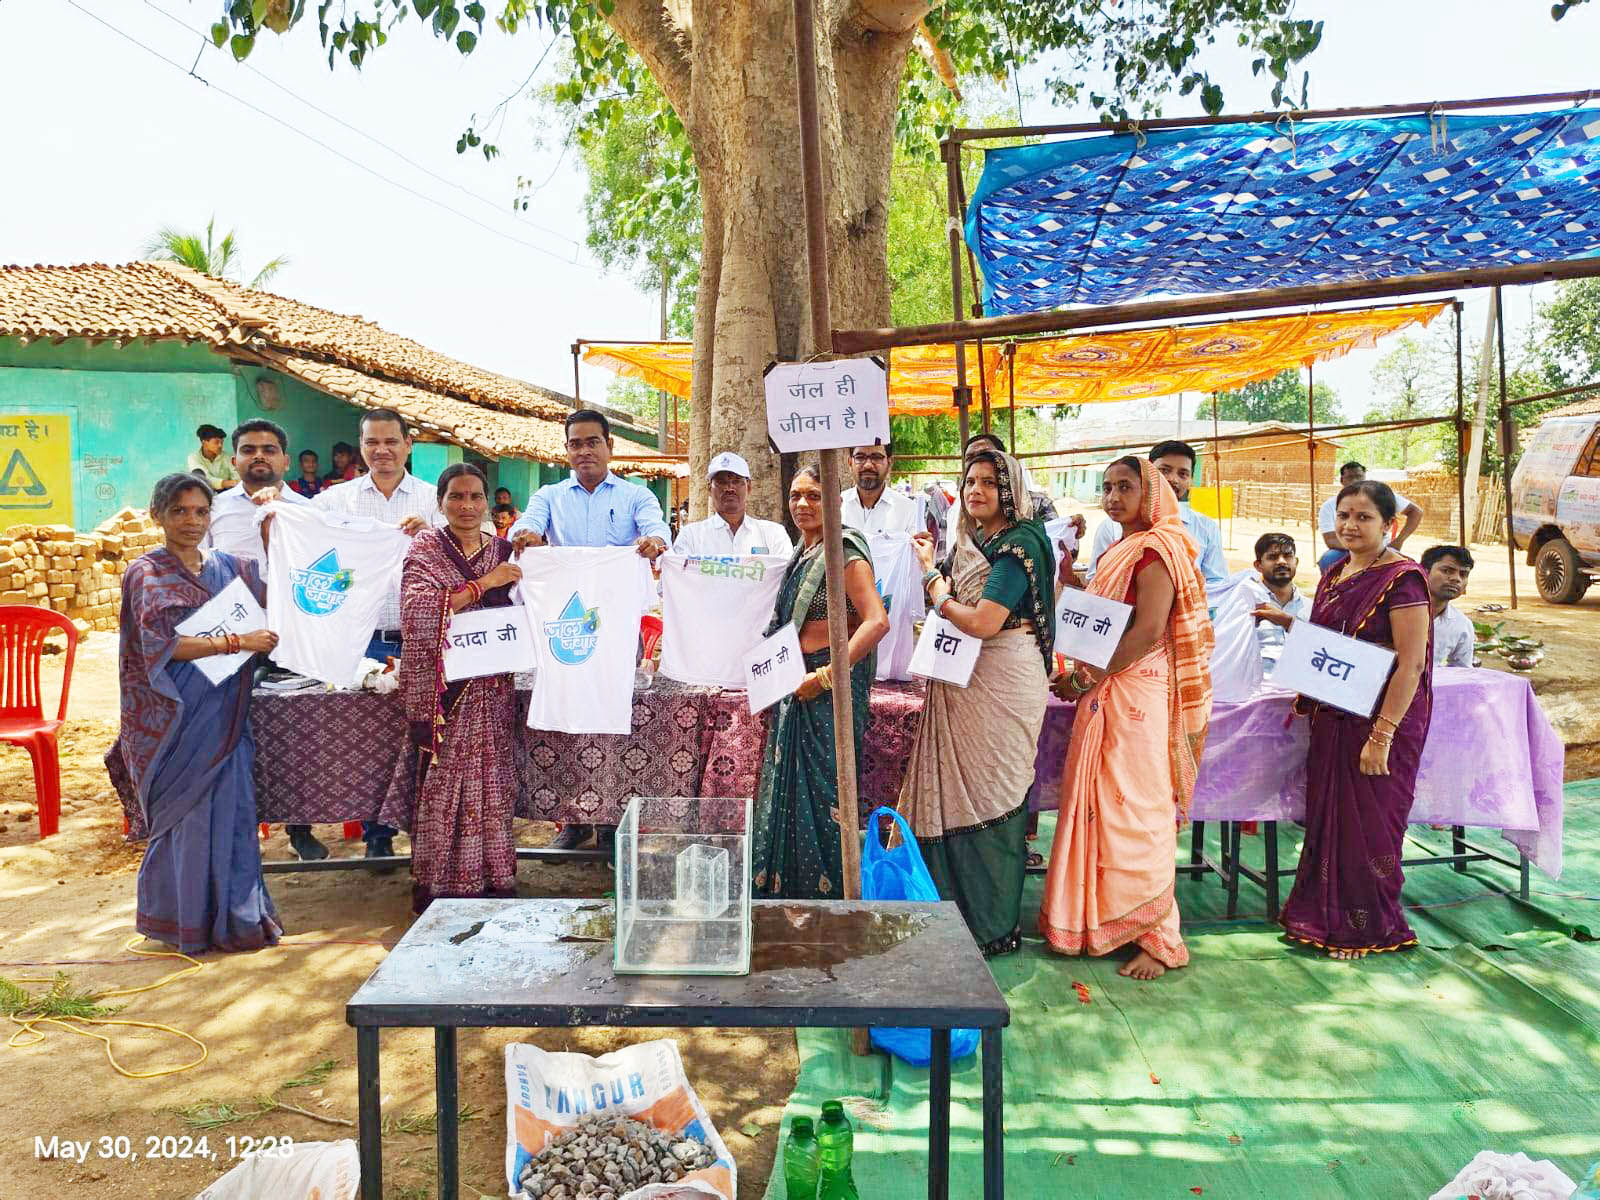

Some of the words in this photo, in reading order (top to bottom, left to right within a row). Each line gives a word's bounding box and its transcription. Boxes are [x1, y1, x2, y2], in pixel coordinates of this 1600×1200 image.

[787, 382, 824, 399] जल
[835, 374, 857, 396] ही
[778, 411, 832, 433] जीवन
[230, 603, 248, 622] जी
[1062, 608, 1089, 628] दादा
[1093, 617, 1112, 636] जी
[452, 631, 487, 648] दादा
[496, 624, 517, 641] जी
[934, 628, 962, 656] बेटा
[751, 658, 772, 681] पिता
[776, 645, 789, 664] जी
[1311, 647, 1355, 681] बेटा
